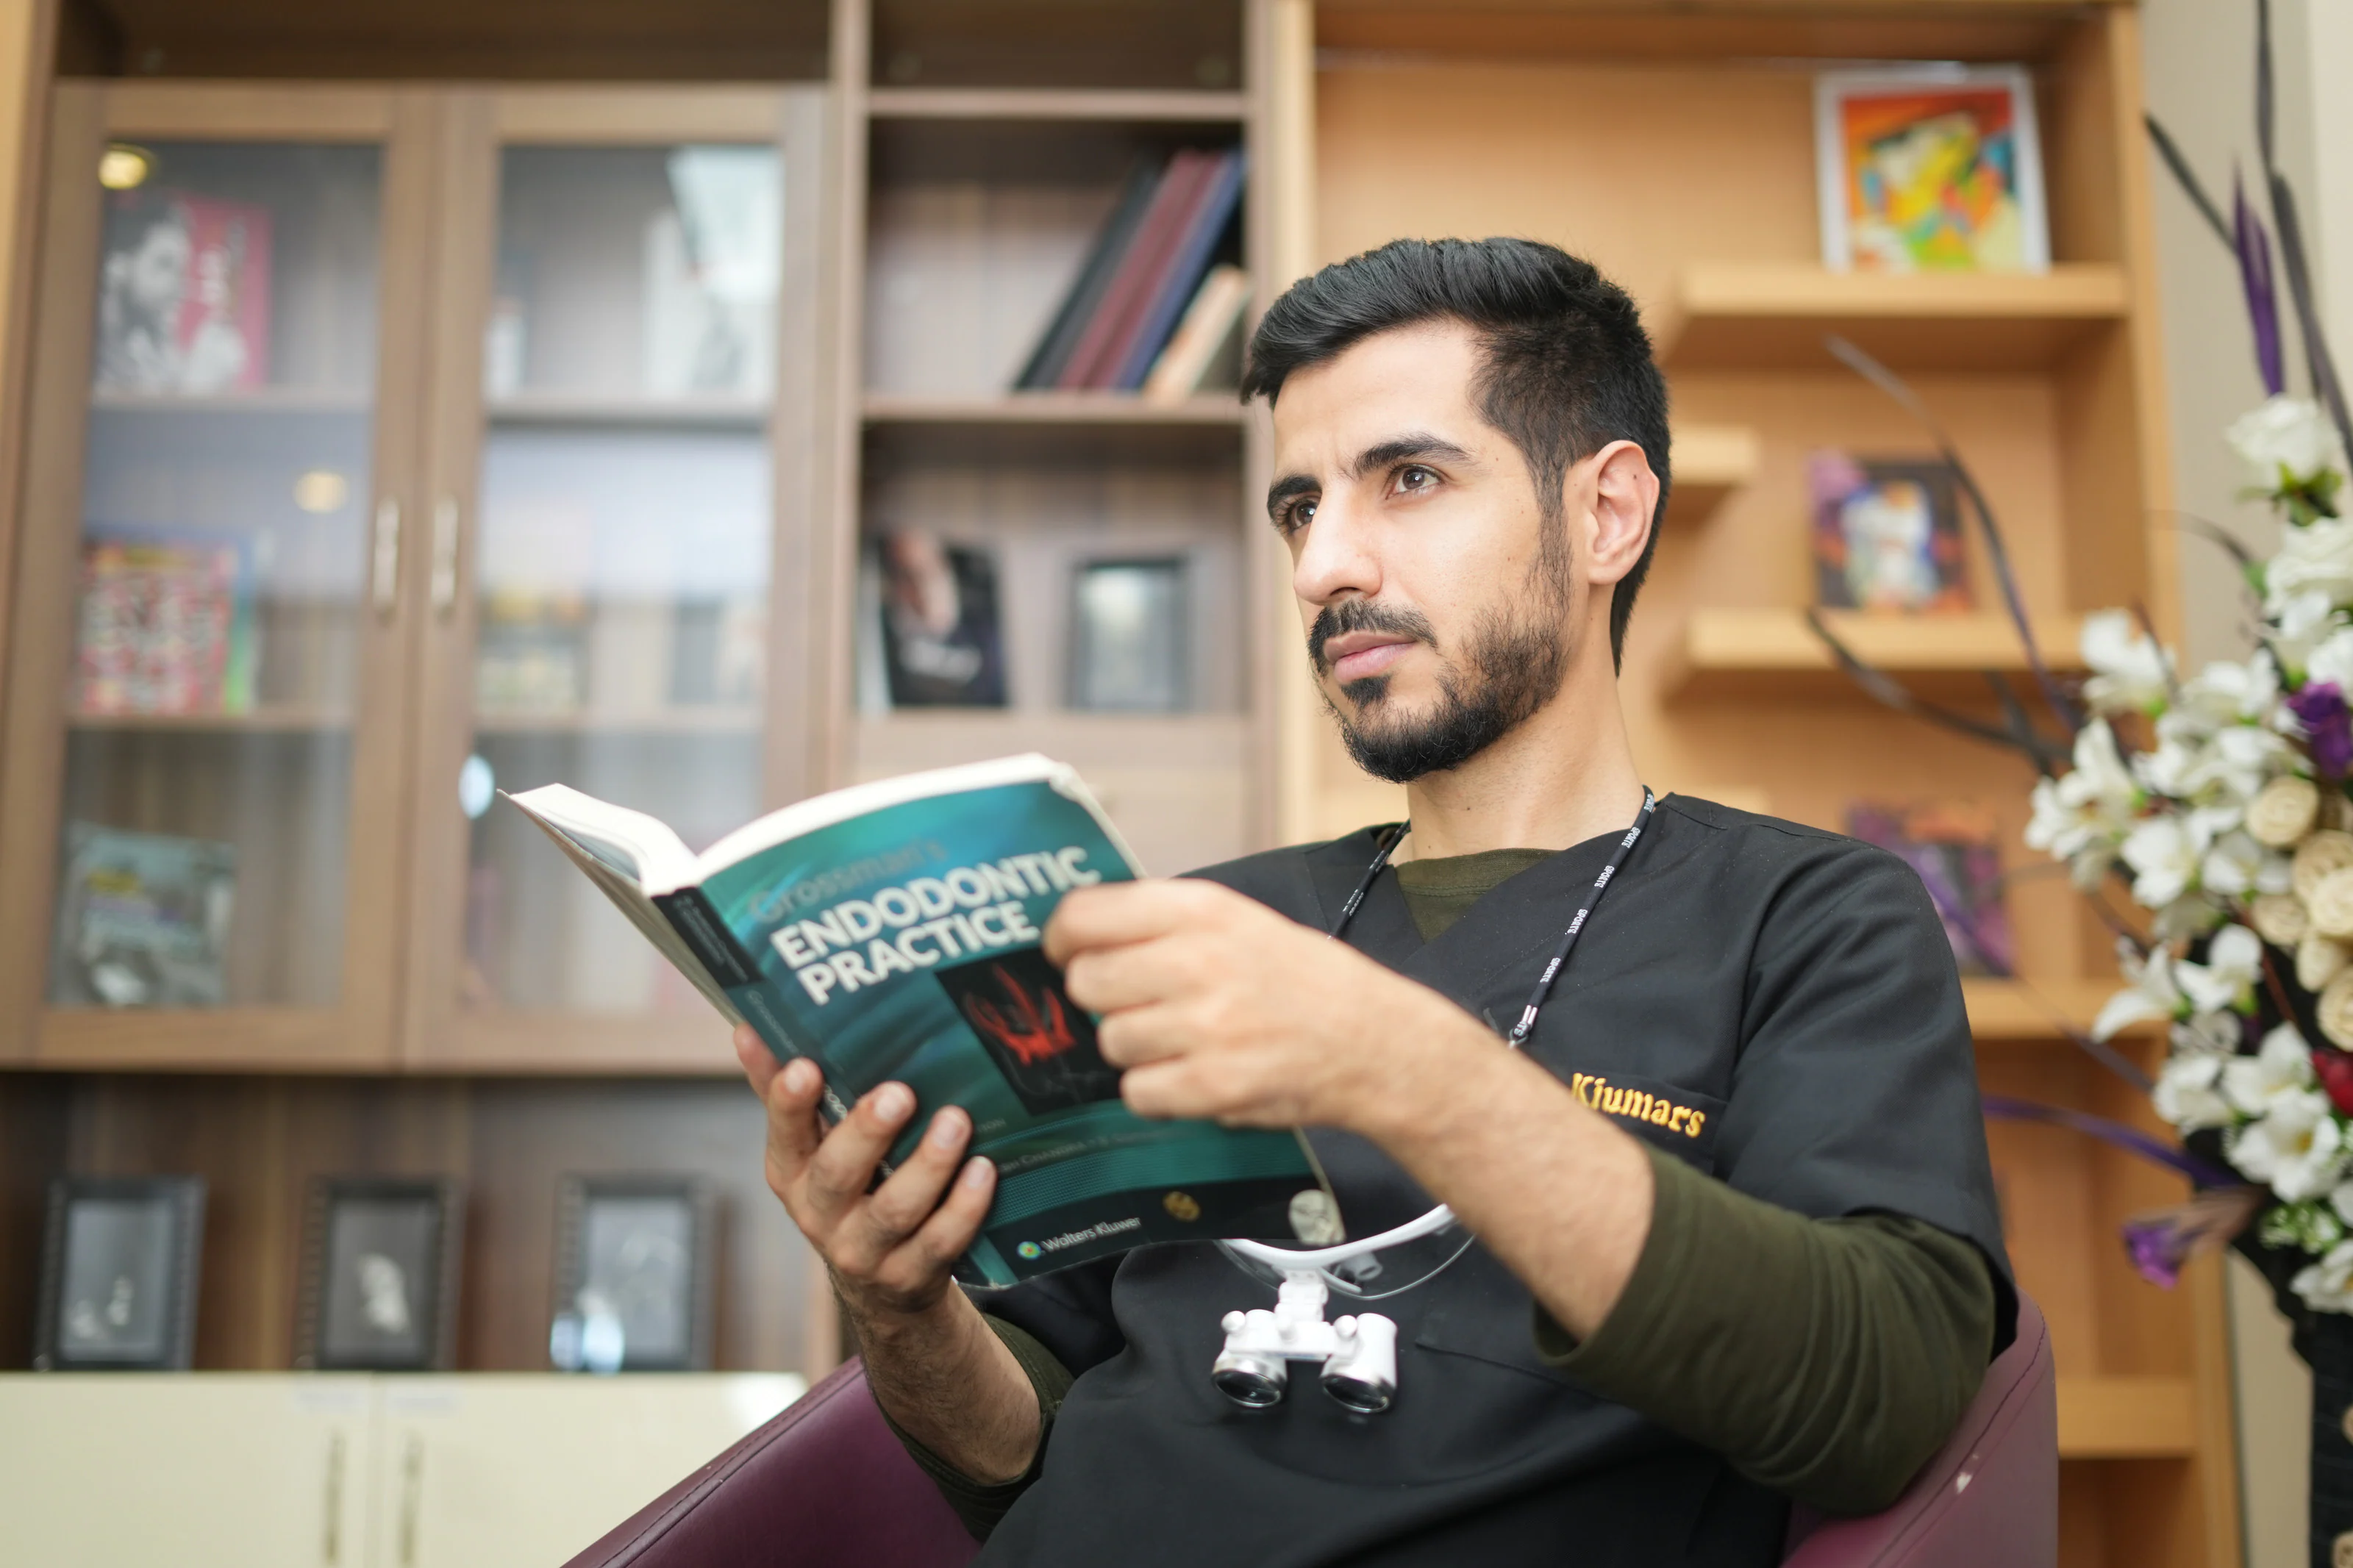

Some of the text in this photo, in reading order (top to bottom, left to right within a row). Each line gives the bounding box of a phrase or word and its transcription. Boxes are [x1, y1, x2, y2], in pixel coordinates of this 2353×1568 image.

[1621, 826, 1640, 848] SPORTS
[1594, 865, 1615, 888] SPORTS
[770, 845, 1101, 970] ENDODONTIC
[1567, 909, 1588, 934] SPORTS
[796, 900, 1041, 1005] PRACTICE
[1571, 1072, 1706, 1138] Kiumars
[1040, 1217, 1142, 1252] Wolters Kluwer
